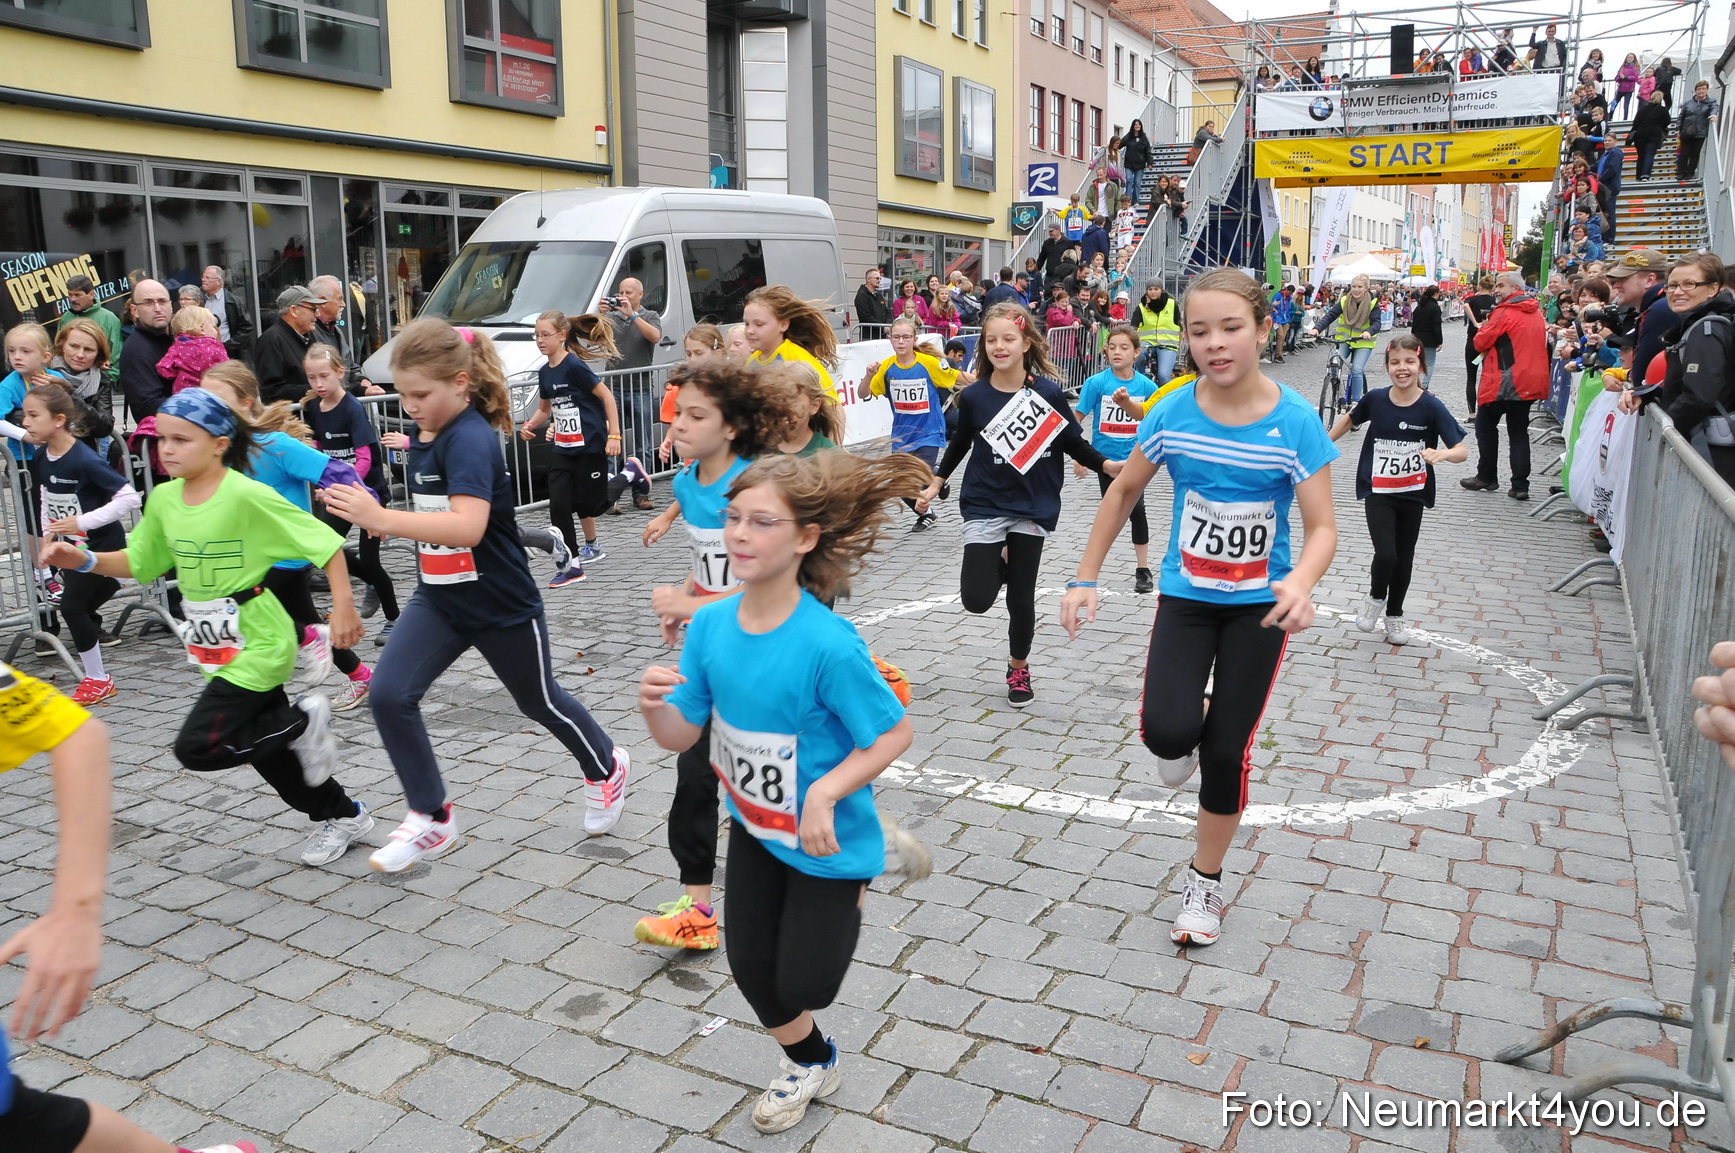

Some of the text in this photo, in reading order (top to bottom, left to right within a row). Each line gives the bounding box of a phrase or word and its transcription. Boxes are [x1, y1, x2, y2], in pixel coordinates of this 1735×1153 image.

[1375, 107, 1421, 117] Verbrauch.
[1424, 105, 1446, 114] Mehr
[1270, 157, 1332, 166] Neumarkter Stadtlauf
[1348, 141, 1454, 169] START
[1471, 151, 1510, 159] Neumarkter
[1329, 218, 1339, 238] BKK
[1322, 239, 1333, 263] Audi
[0, 251, 47, 280] SEASON
[118, 276, 129, 291] 14
[894, 387, 925, 401] 7167
[986, 397, 1026, 440] PARTL Neumarkt
[996, 400, 1047, 451] 7554
[1379, 454, 1422, 475] 7543
[1186, 499, 1261, 521] PARTL Neumarkt
[1190, 516, 1268, 558] 7599
